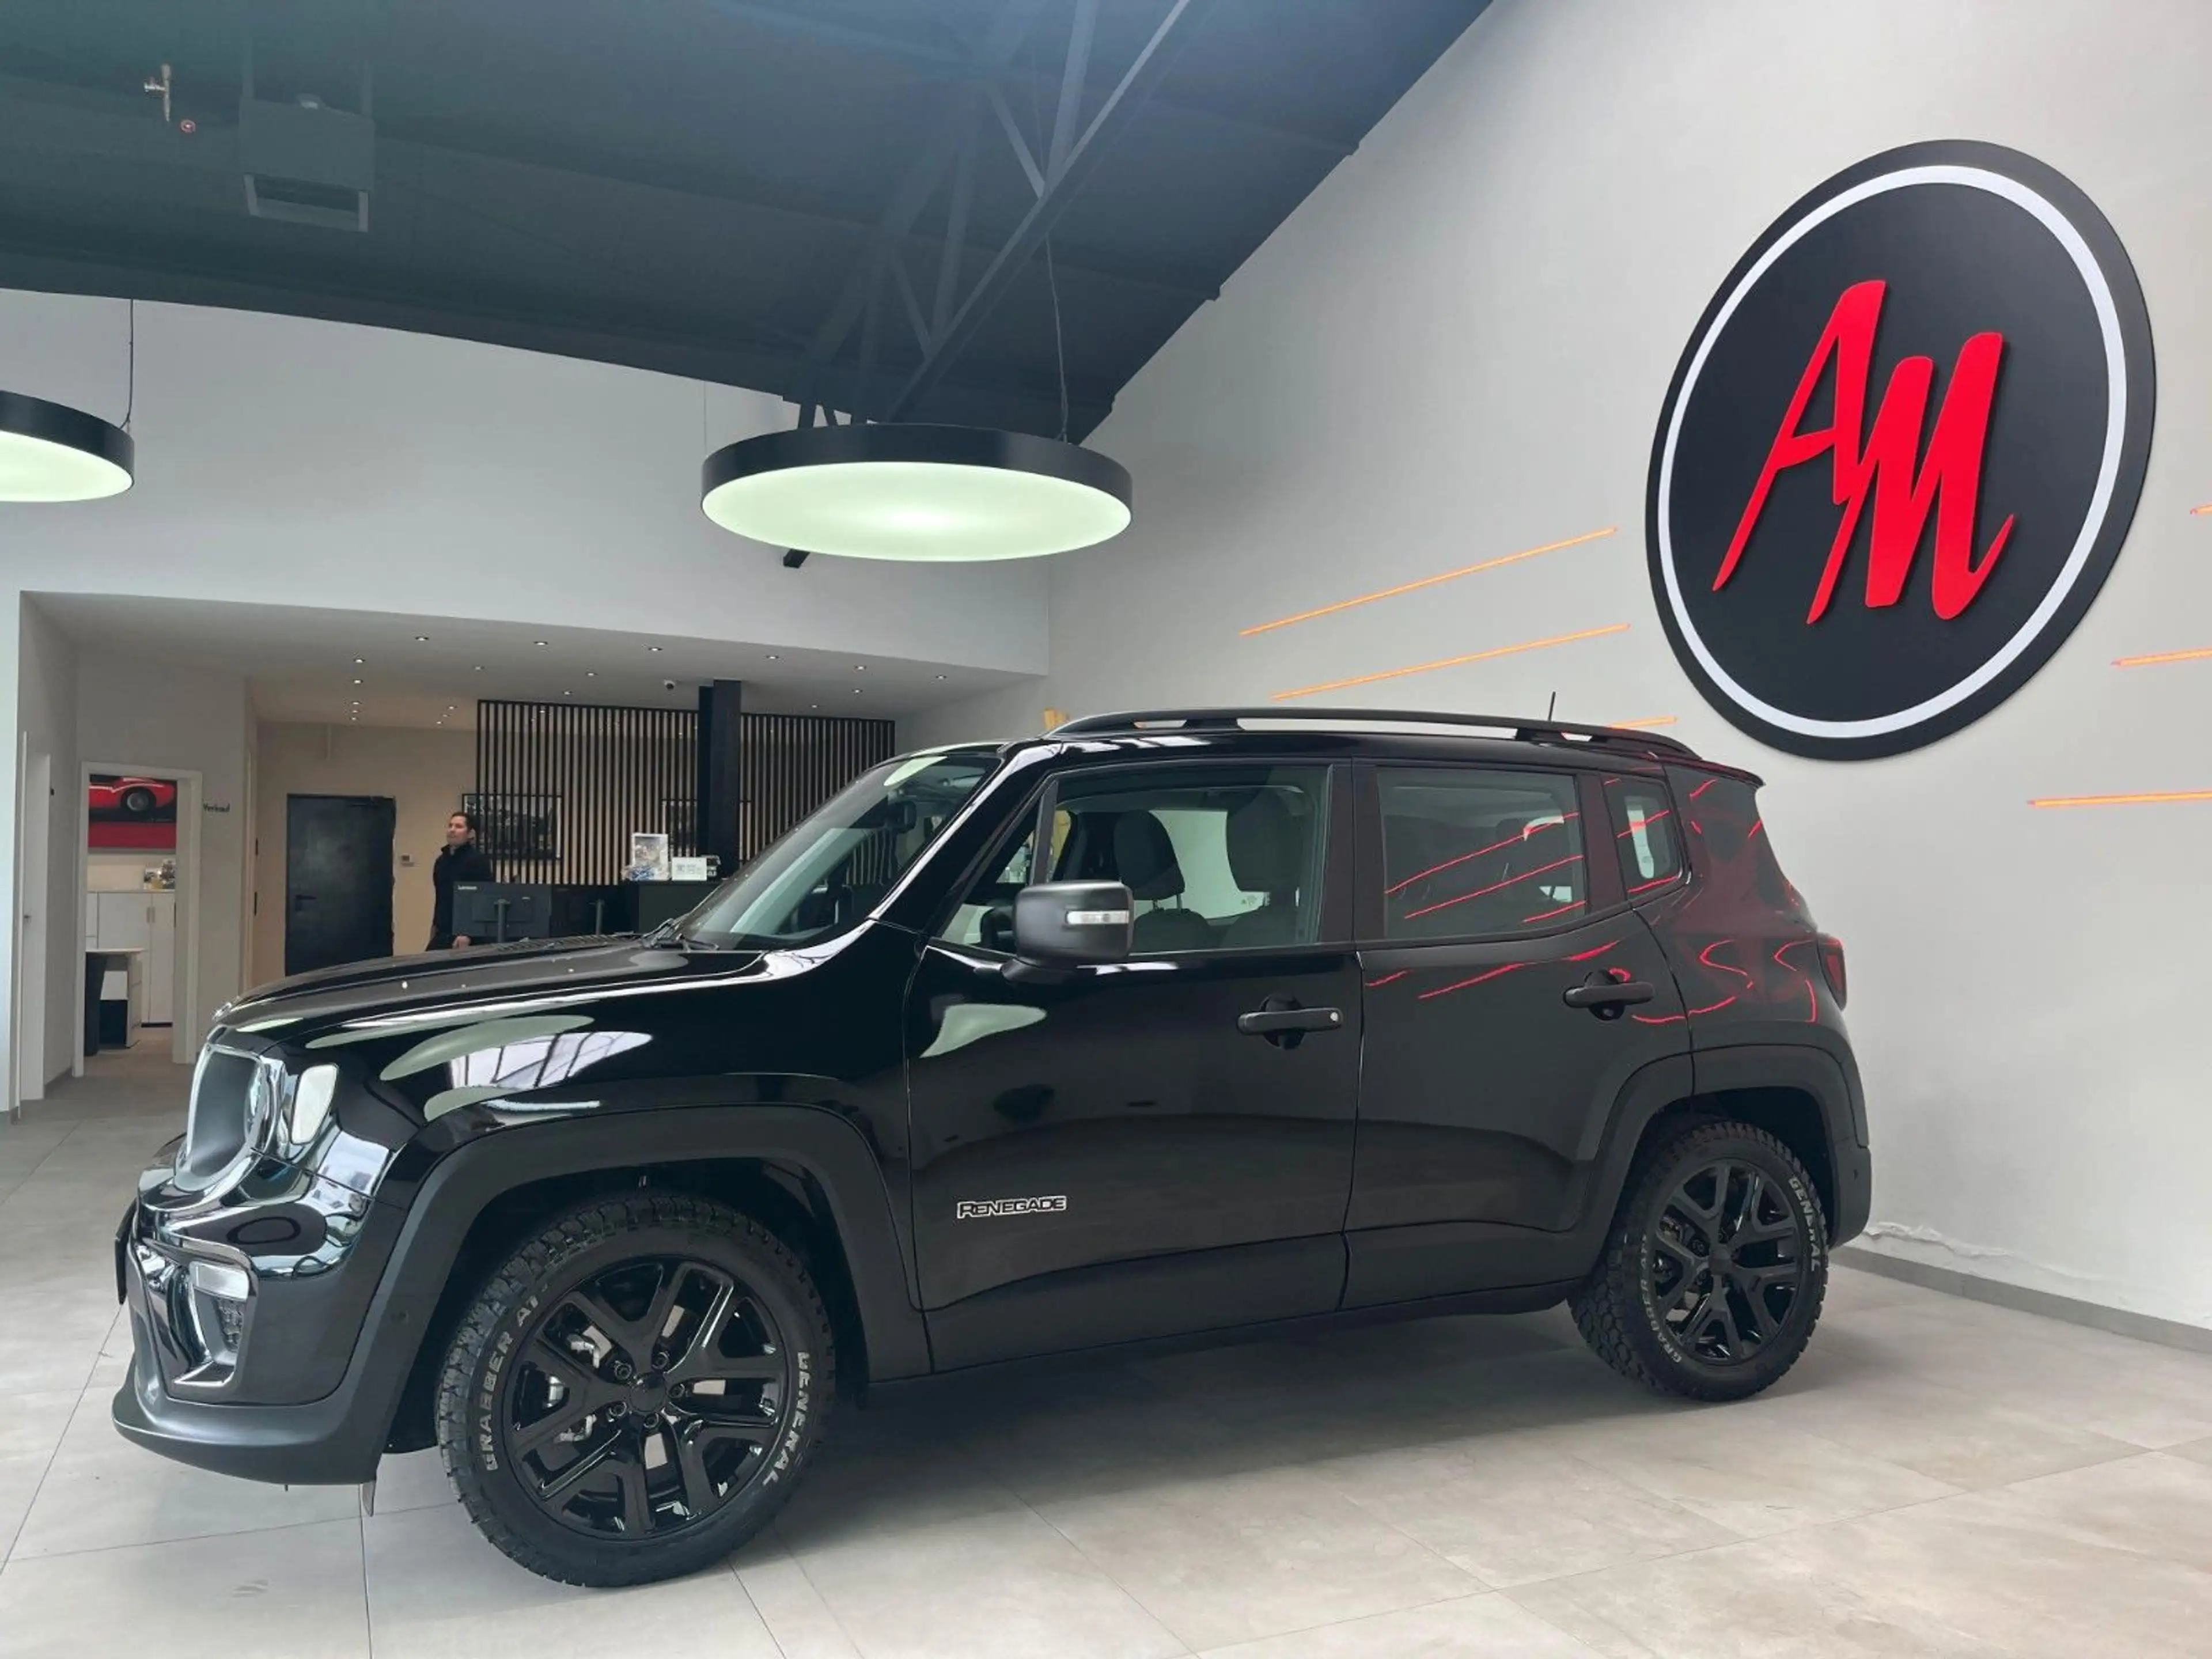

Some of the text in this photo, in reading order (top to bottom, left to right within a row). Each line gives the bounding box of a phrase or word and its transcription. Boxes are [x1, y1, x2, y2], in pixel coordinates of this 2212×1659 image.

[1713, 279, 2014, 624] AM
[1789, 1177, 1820, 1272] GENERAL
[479, 1331, 514, 1471] GRABBER
[762, 1351, 810, 1486] GENERAL
